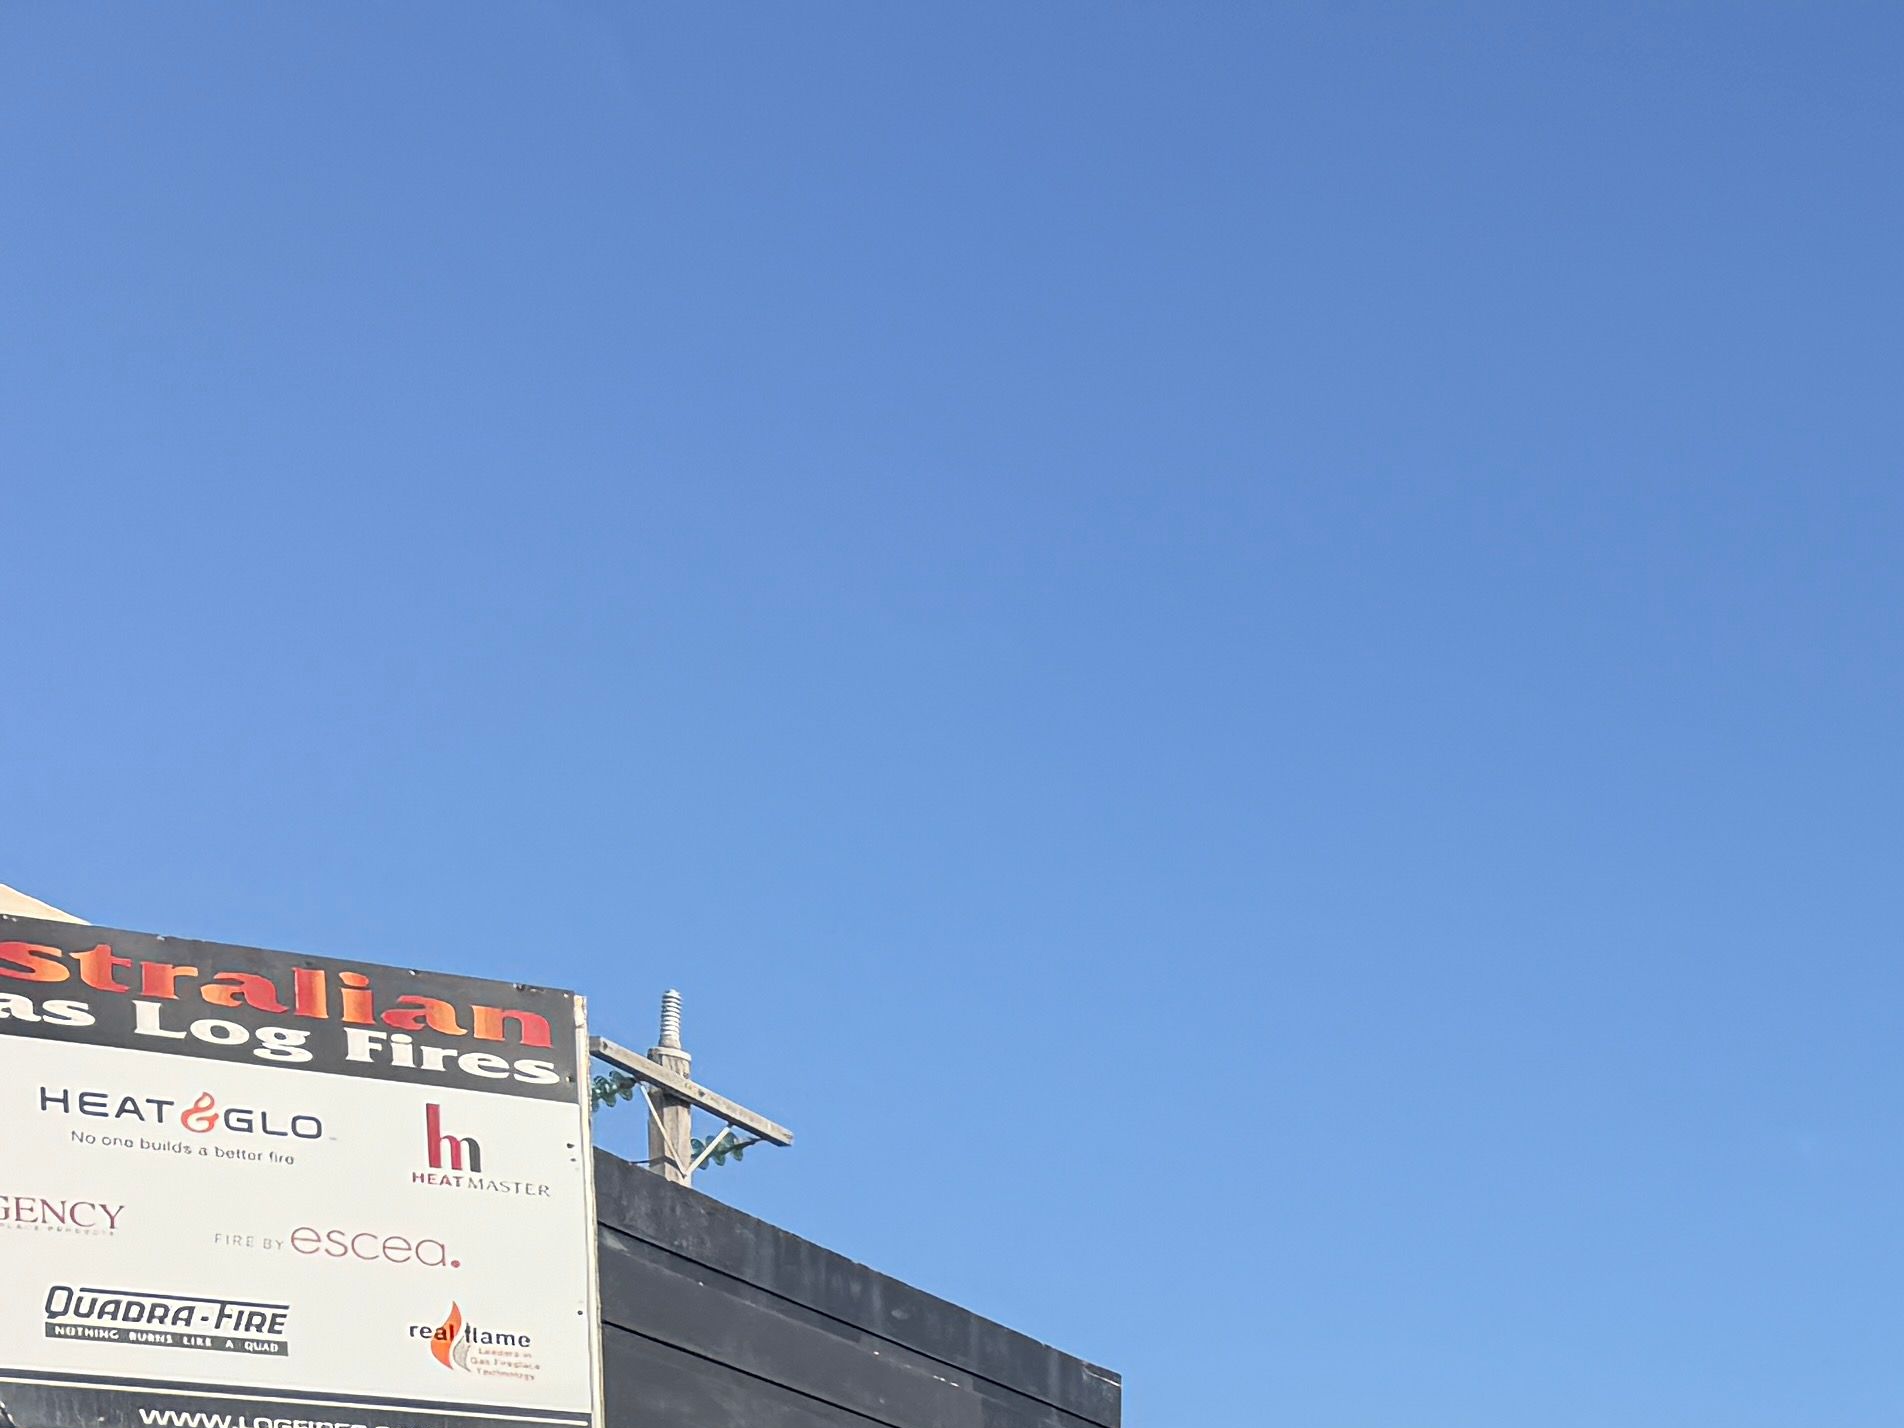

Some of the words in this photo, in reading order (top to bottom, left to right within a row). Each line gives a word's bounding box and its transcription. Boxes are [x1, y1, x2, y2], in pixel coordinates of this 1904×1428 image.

[133, 1000, 313, 1062] Log
[344, 1027, 560, 1084] Fires
[140, 1136, 192, 1155] builds
[214, 1233, 255, 1248] FIRE
[263, 1239, 285, 1250] BY
[54, 1325, 120, 1340] NOTHING
[225, 1340, 234, 1349] A
[245, 1341, 279, 1353] QUAD
